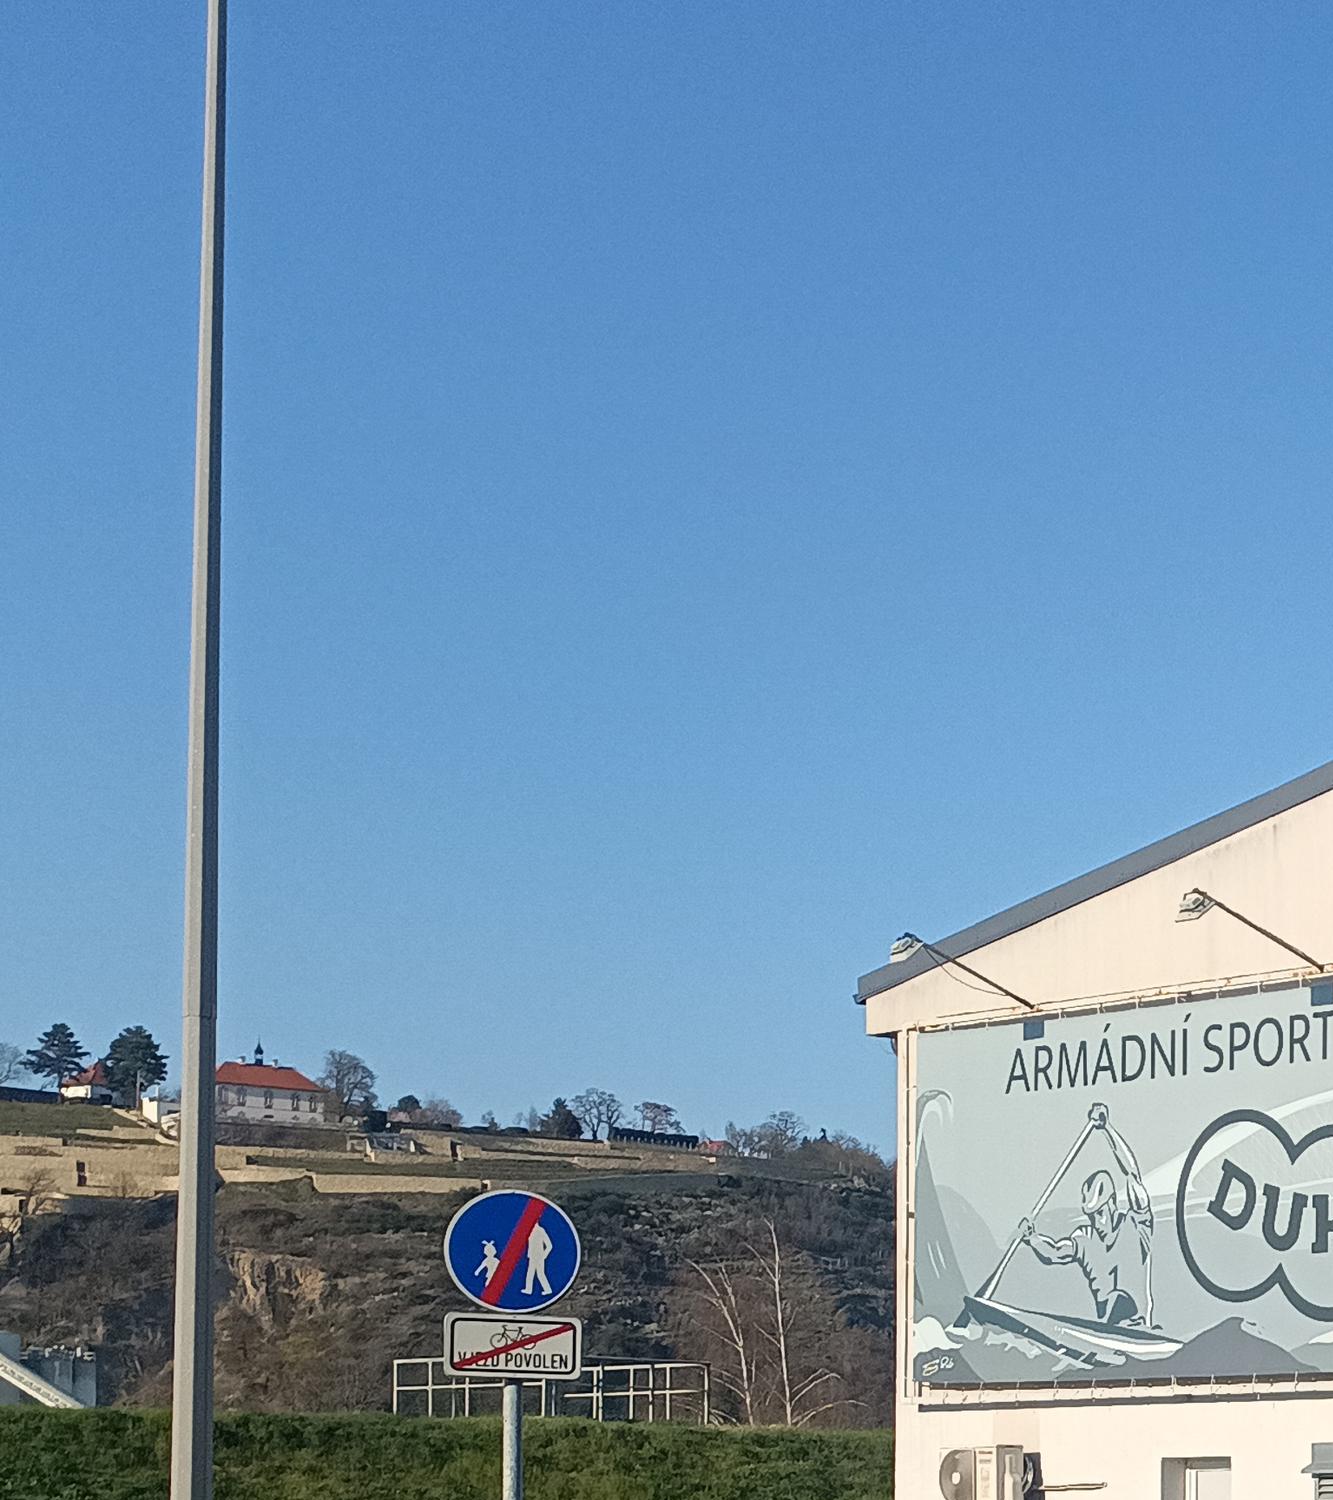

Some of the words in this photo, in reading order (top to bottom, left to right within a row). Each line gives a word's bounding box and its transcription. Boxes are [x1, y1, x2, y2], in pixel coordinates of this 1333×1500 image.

[1004, 1012, 1192, 1095] ARMÁDNÍ
[458, 1351, 499, 1368] VZD
[504, 1352, 568, 1370] POVOLEN
